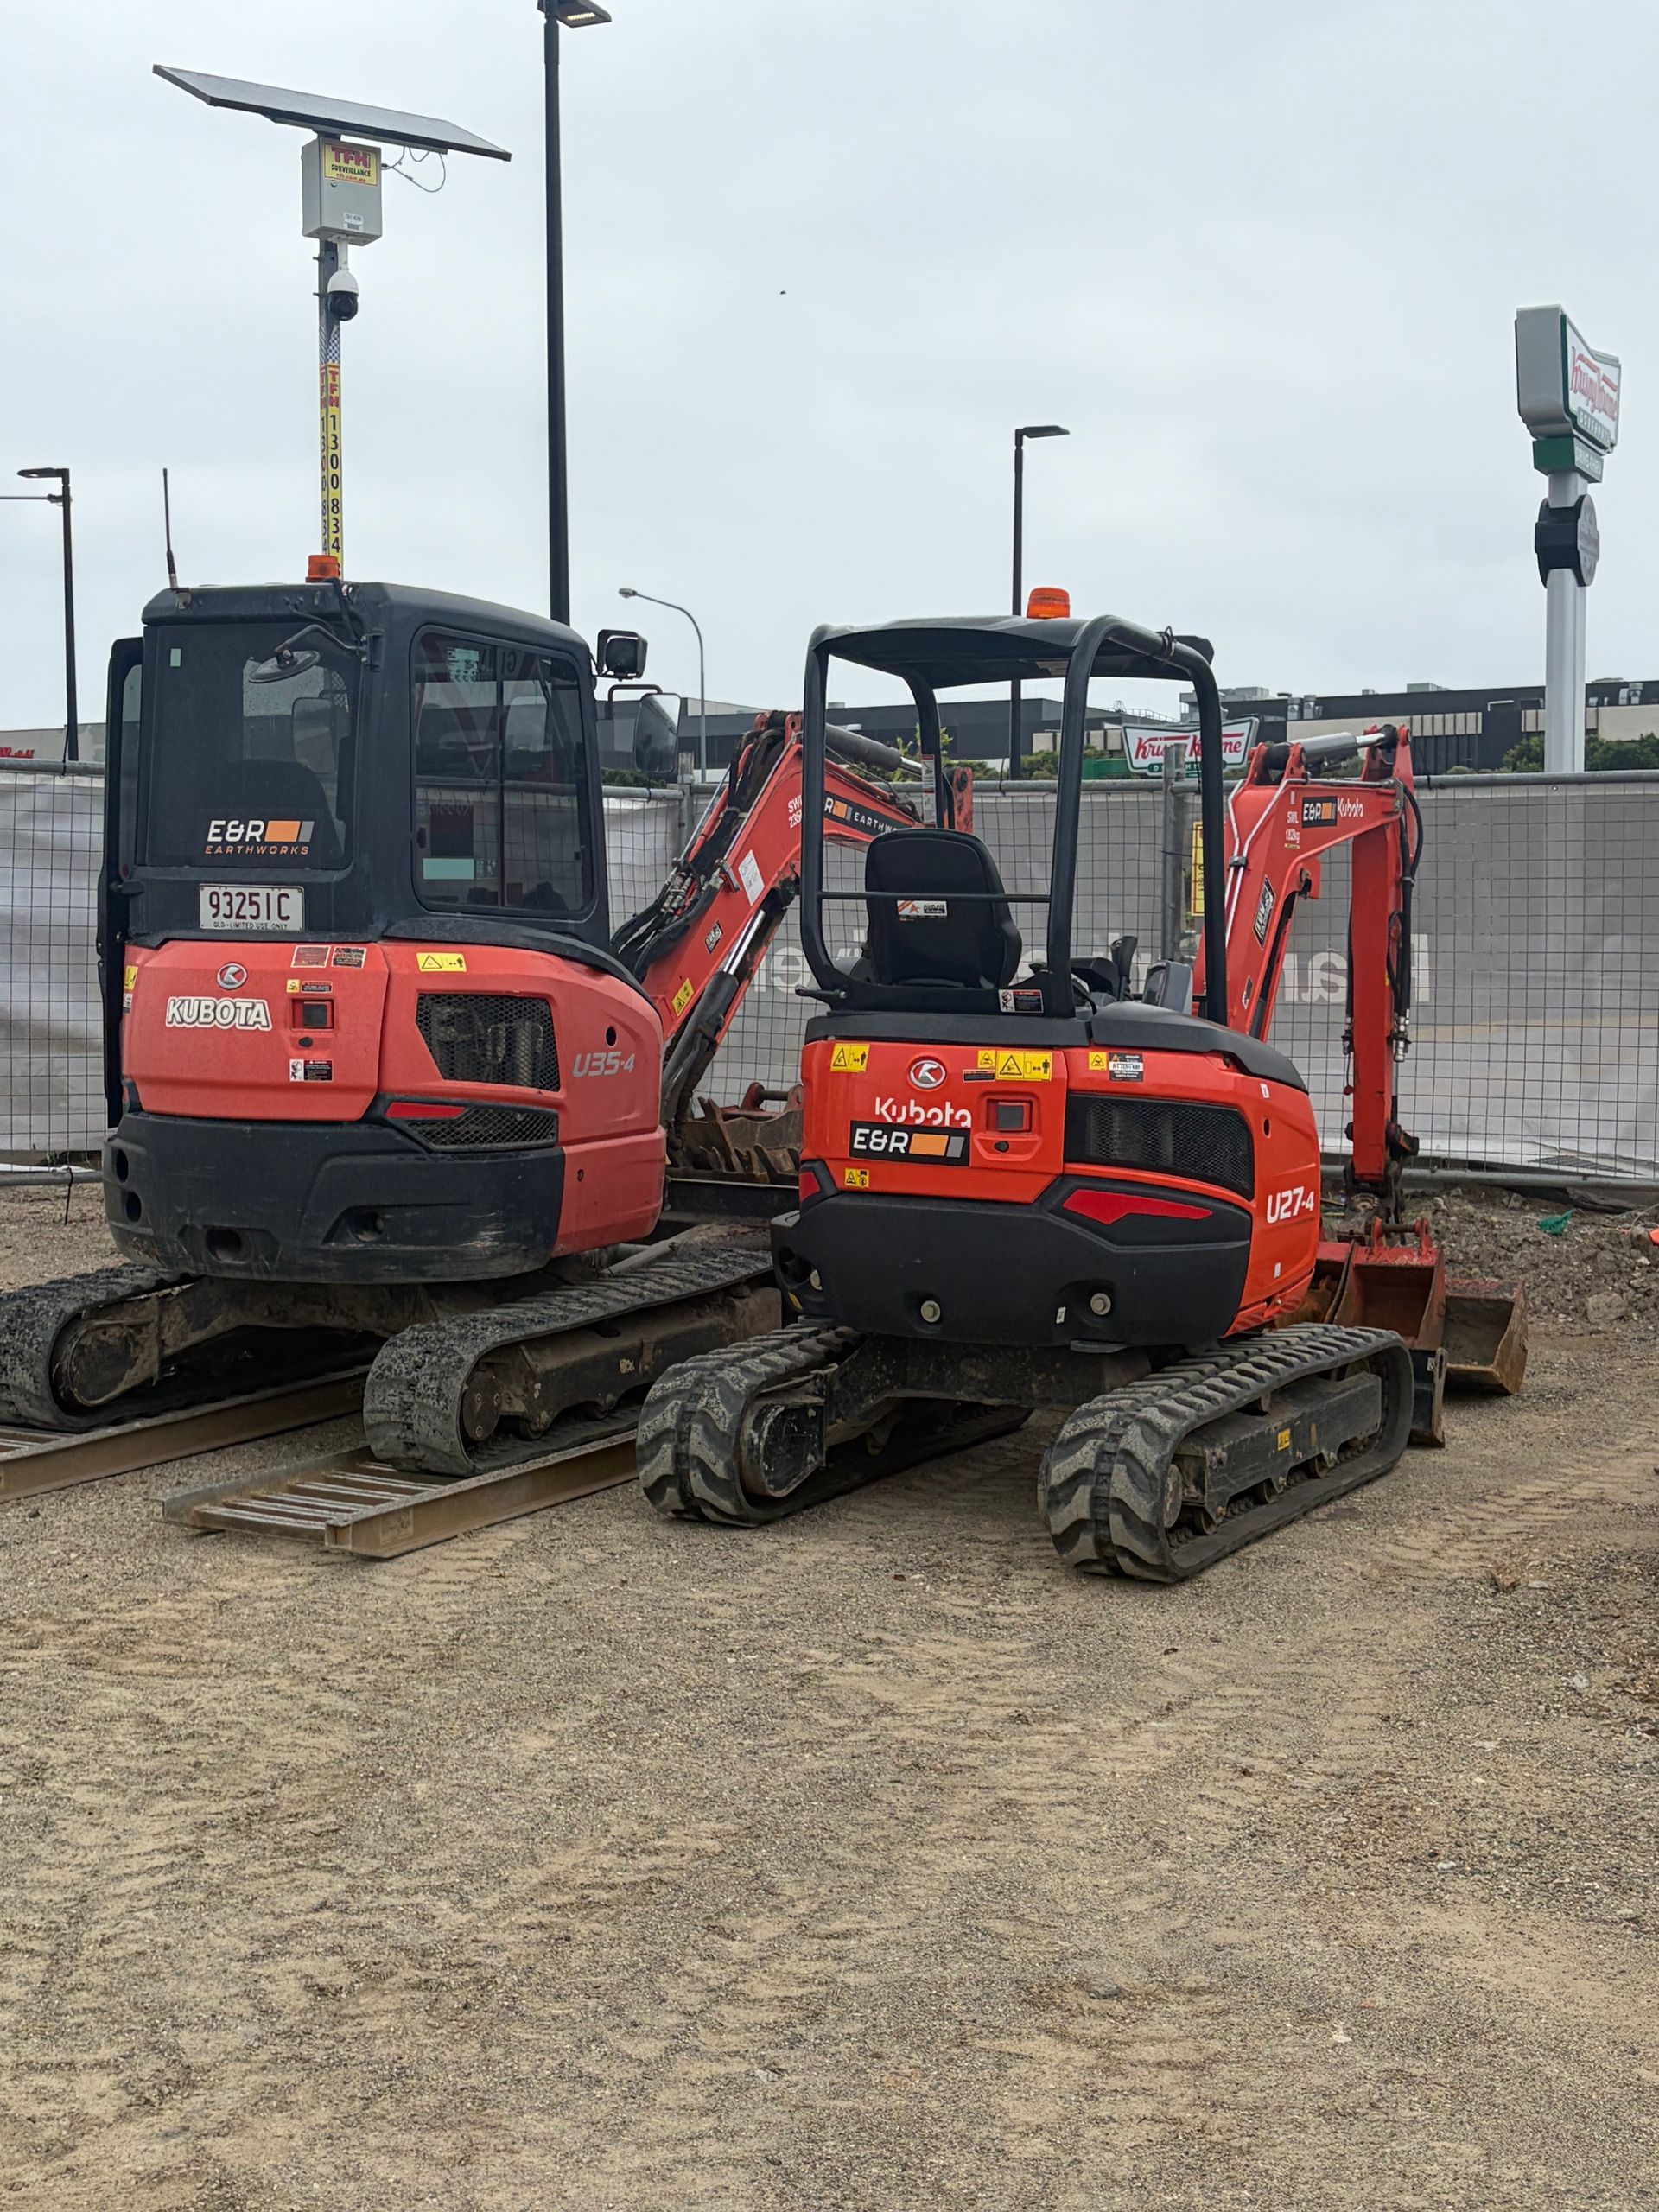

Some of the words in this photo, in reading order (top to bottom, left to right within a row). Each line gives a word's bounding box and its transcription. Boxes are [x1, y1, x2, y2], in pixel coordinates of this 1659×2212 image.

[331, 163, 371, 177] SURVEILLANCE
[328, 370, 340, 408] TFH
[329, 414, 340, 490] 1300
[330, 498, 341, 554] 834
[1302, 803, 1322, 821] E&R
[1337, 798, 1363, 817] Kubota
[207, 820, 265, 842] E&R
[205, 845, 309, 855] EARTHWORKS
[167, 998, 271, 1030] KUBOTA
[572, 1052, 635, 1077] U35-4
[874, 1096, 972, 1128] Kubota
[853, 1128, 908, 1154] E&R
[1267, 1186, 1314, 1224] U27-4
